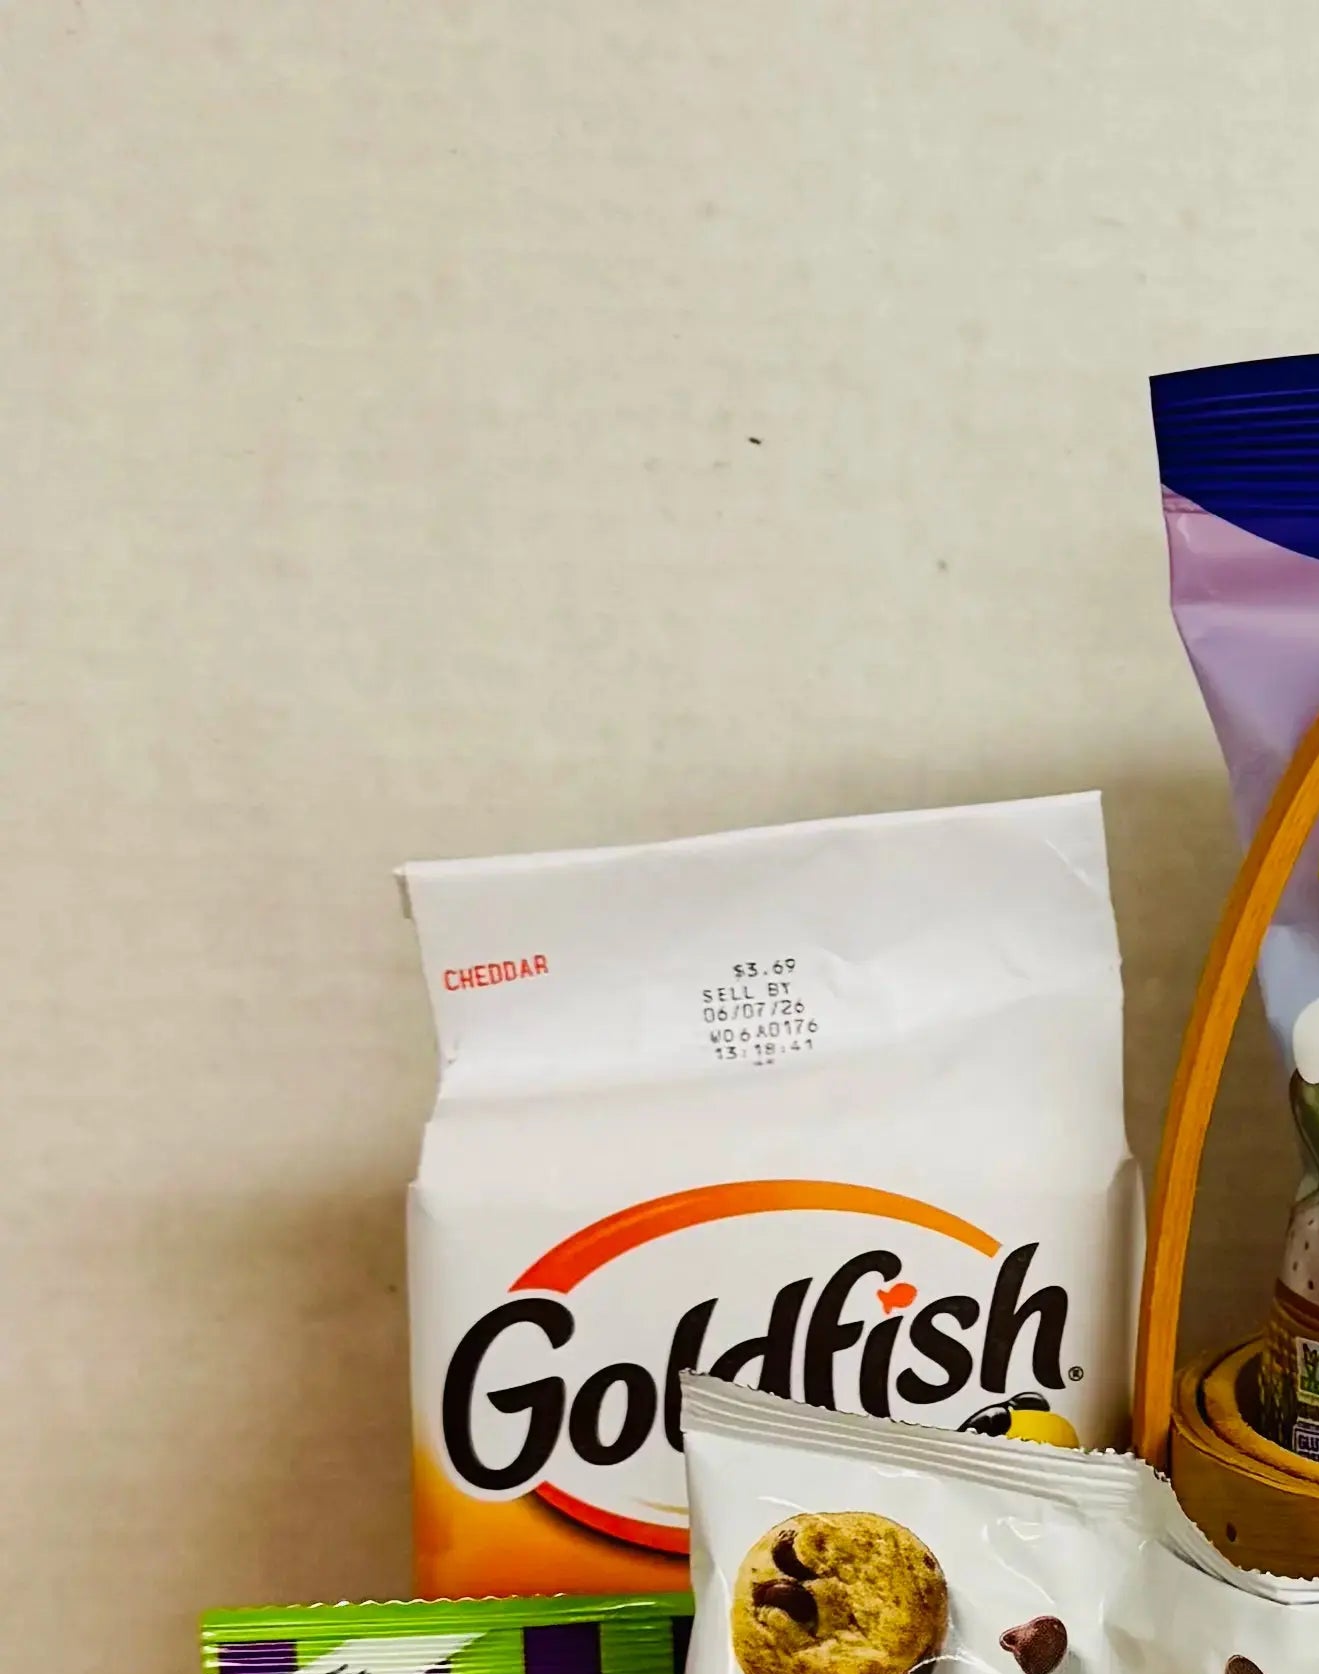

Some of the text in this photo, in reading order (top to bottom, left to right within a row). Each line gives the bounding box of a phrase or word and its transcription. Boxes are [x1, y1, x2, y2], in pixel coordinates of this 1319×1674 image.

[443, 954, 549, 992] CHEDDAR
[732, 957, 796, 981] $3.69
[702, 982, 791, 1003] SELL BY
[441, 1241, 1069, 1490] Goldfish
